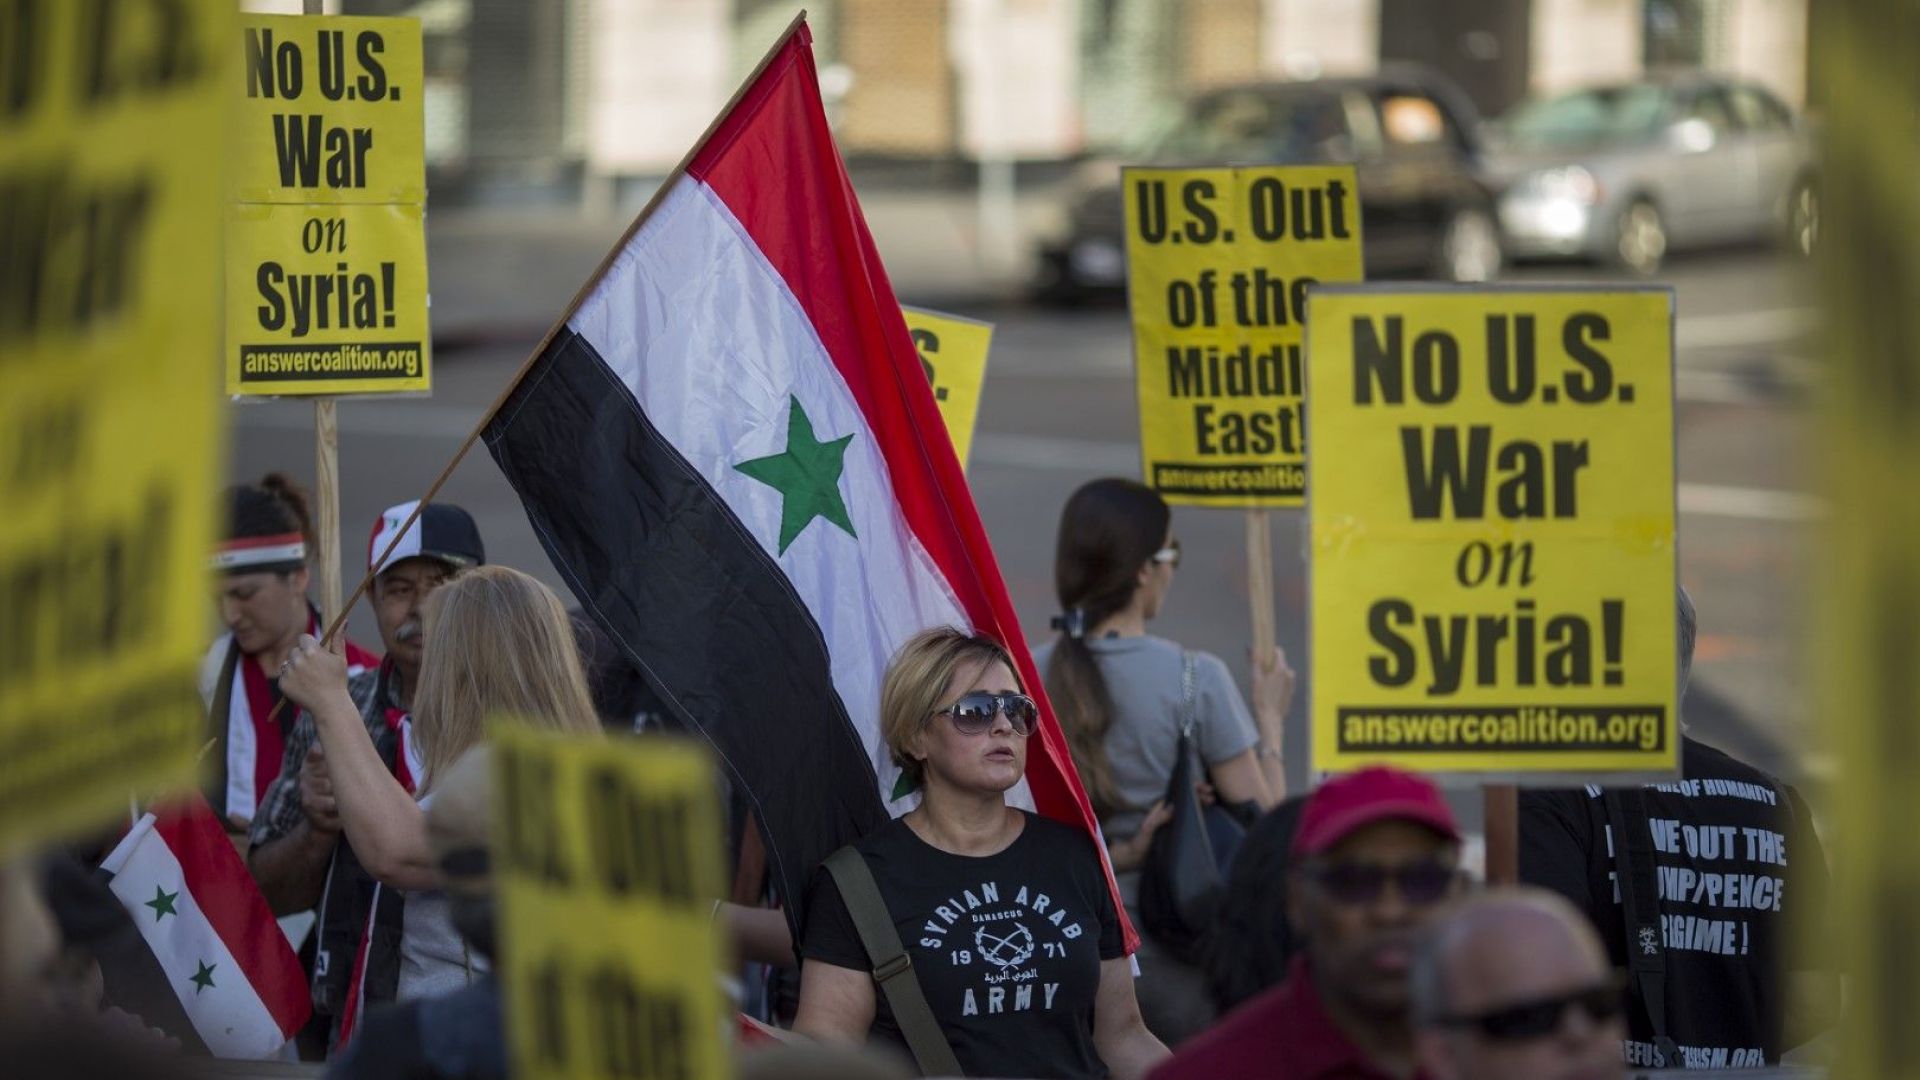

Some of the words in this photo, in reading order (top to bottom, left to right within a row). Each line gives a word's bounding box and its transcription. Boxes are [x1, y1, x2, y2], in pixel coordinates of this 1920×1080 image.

[245, 29, 302, 100] No
[318, 30, 400, 102] U.S.
[273, 114, 372, 188] War
[1137, 180, 1235, 244] U.S.
[1250, 177, 1350, 242] Out
[303, 218, 347, 254] on
[257, 262, 396, 338] Syria!
[1168, 270, 1217, 328] of
[245, 345, 417, 375] answercoalition.org
[1167, 345, 1302, 398] Middl
[1352, 316, 1460, 405] No
[1486, 312, 1635, 405] U.S.
[1158, 467, 1305, 489] answercoalitio
[1400, 425, 1589, 520] War
[1456, 540, 1535, 587] on
[1368, 598, 1625, 696] Syria!
[1344, 709, 1659, 748] answercoalition.org
[1703, 779, 1776, 806] HUMANITY
[1682, 825, 1737, 860] OUT
[1742, 827, 1787, 866] THE
[1608, 865, 1785, 911] TMP/PENCE
[920, 882, 999, 948] SYRIAN
[1015, 886, 1082, 939] ARAB
[972, 909, 1023, 923] DAMASCUS
[951, 950, 972, 965] 19
[1043, 942, 1066, 958] 71
[963, 983, 1060, 1016] ARMY
